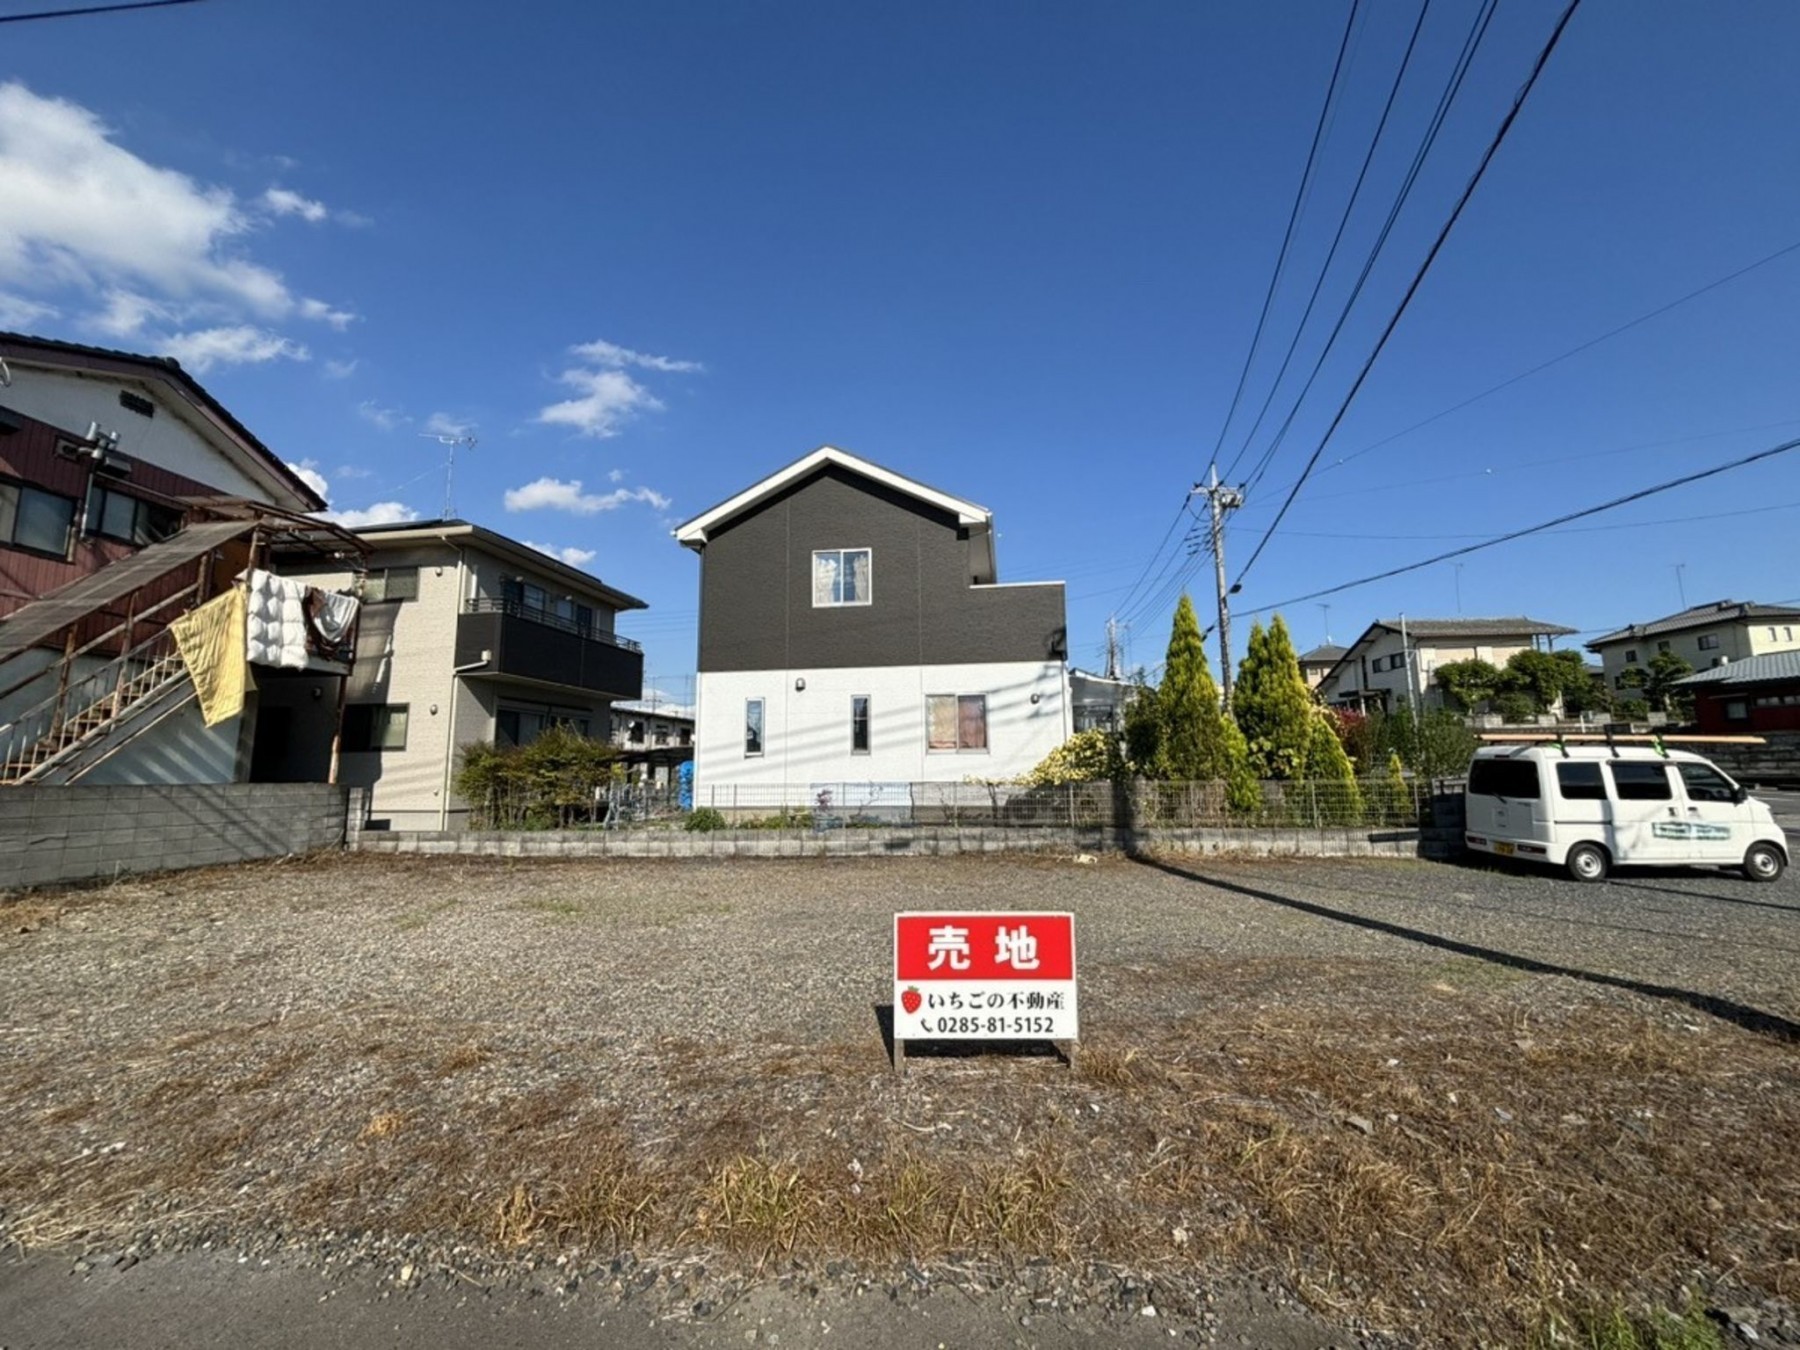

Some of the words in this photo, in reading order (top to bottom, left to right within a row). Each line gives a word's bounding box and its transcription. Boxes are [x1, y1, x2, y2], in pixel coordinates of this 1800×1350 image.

[927, 925, 1040, 970] 売地
[928, 991, 1065, 1010] いちごの不動産
[937, 1016, 1054, 1033] 0285-81-5152
